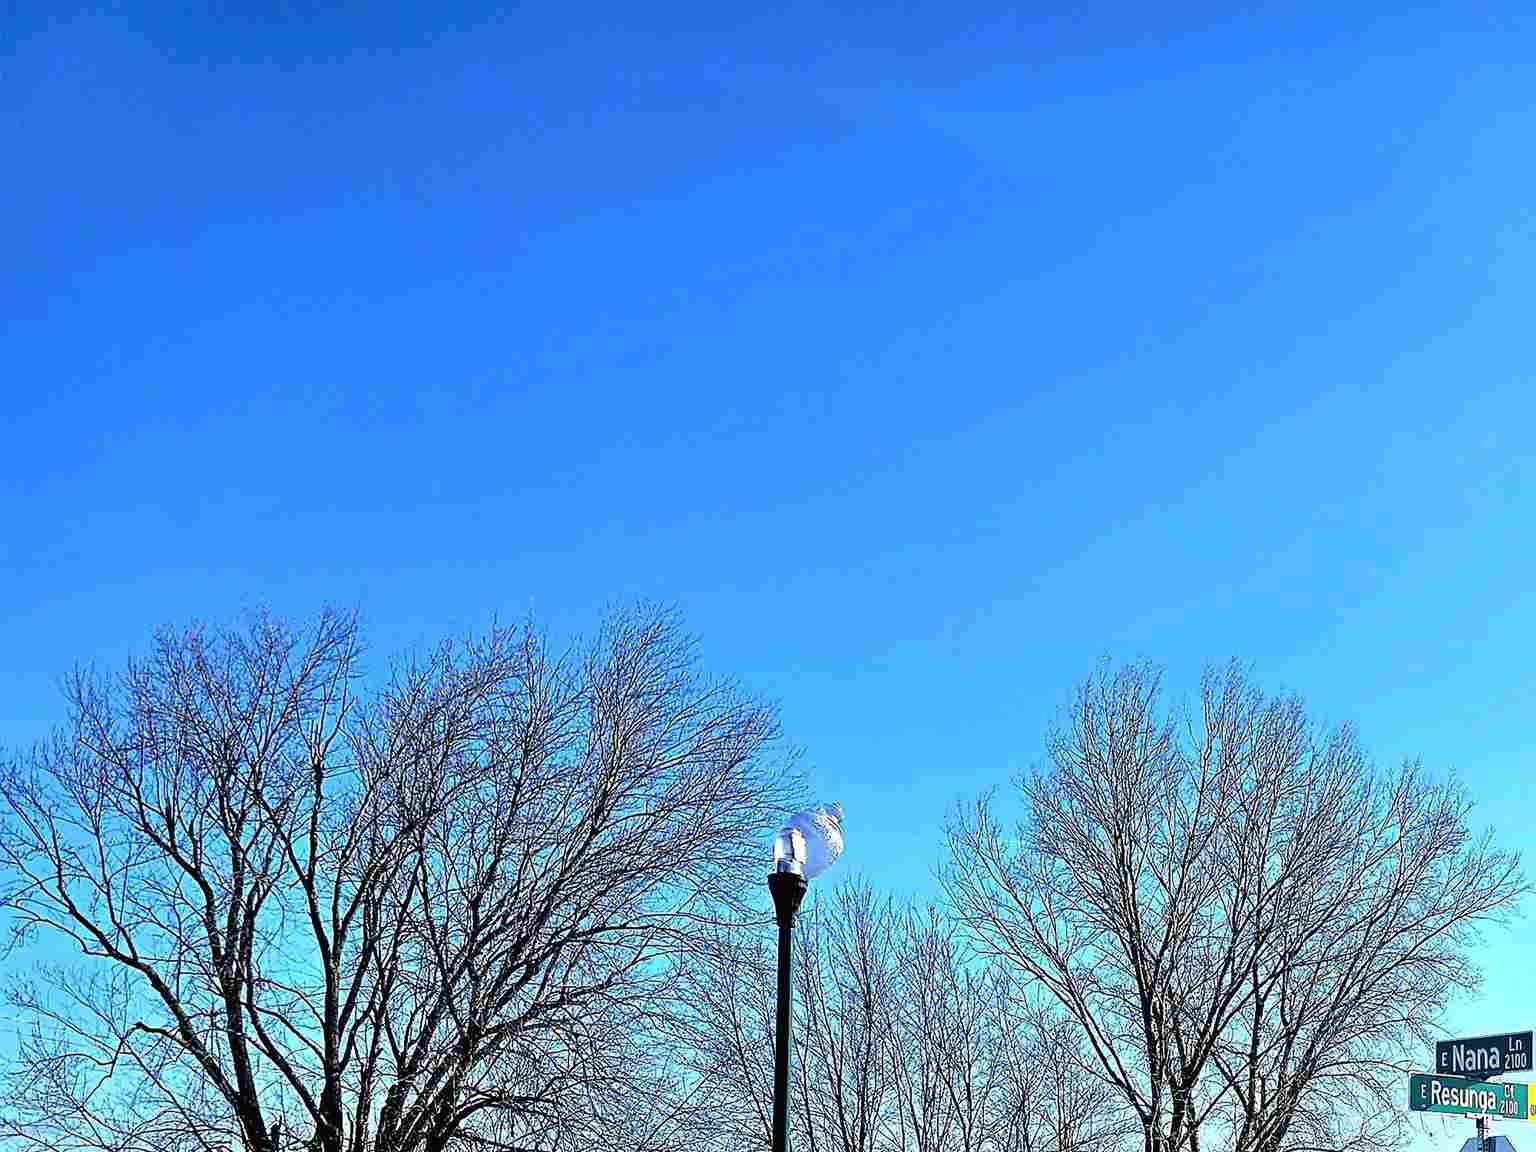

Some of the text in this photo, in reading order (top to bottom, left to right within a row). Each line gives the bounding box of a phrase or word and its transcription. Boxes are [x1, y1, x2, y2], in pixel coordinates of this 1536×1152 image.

[1441, 1036, 1523, 1072] E Nana Ln
[1504, 1052, 1528, 1070] 2100
[1421, 1080, 1515, 1113] E Resunga Ct
[1499, 1100, 1519, 1115] 2100
